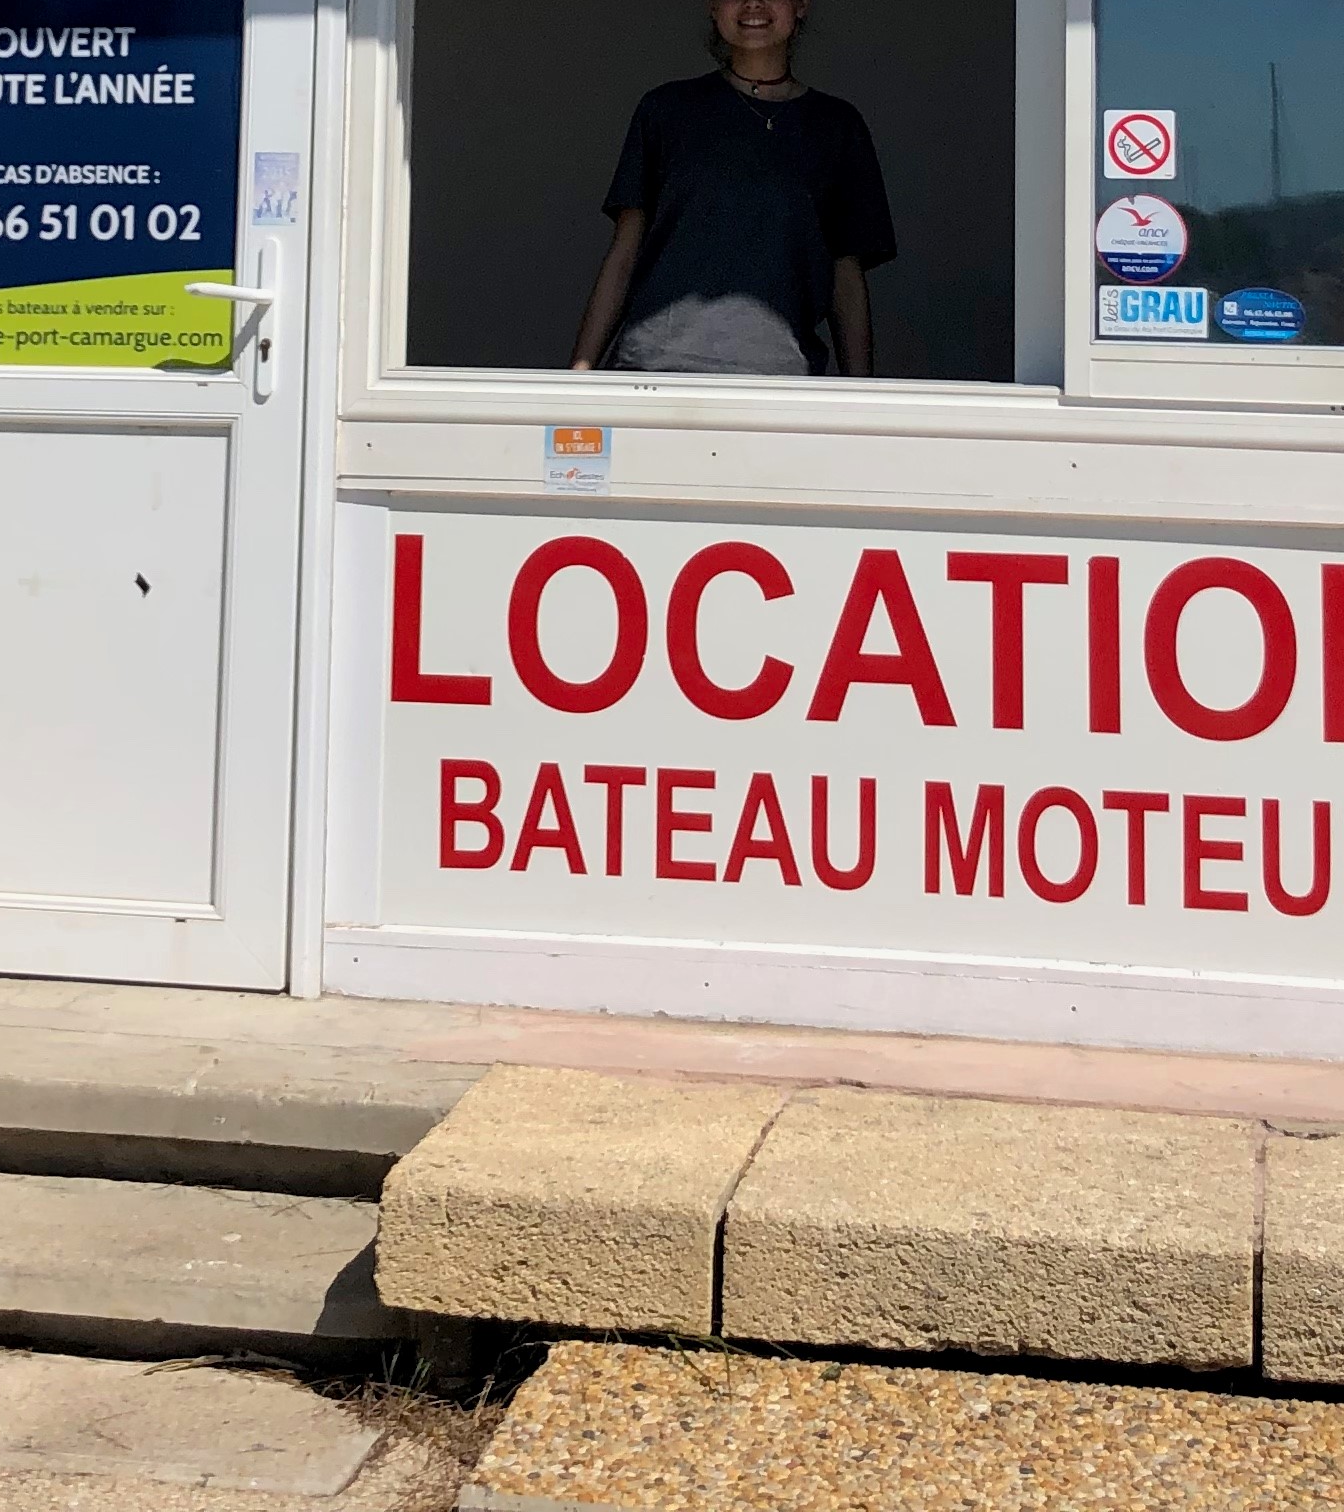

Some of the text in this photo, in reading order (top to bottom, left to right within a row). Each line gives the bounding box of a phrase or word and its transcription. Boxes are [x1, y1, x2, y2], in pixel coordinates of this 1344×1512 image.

[55, 65, 194, 104] L'ANNÉE
[36, 164, 150, 184] D'ABSENCE
[154, 171, 160, 183] :
[40, 205, 77, 240] 51
[90, 204, 134, 240] 01
[148, 205, 200, 240] 02
[1139, 228, 1168, 238] ancv
[8, 300, 67, 314] bateaux
[72, 304, 80, 314] à
[85, 300, 144, 317] vendre
[147, 303, 166, 317] sur
[1120, 289, 1204, 324] GRAU
[440, 759, 876, 890] BATEAU
